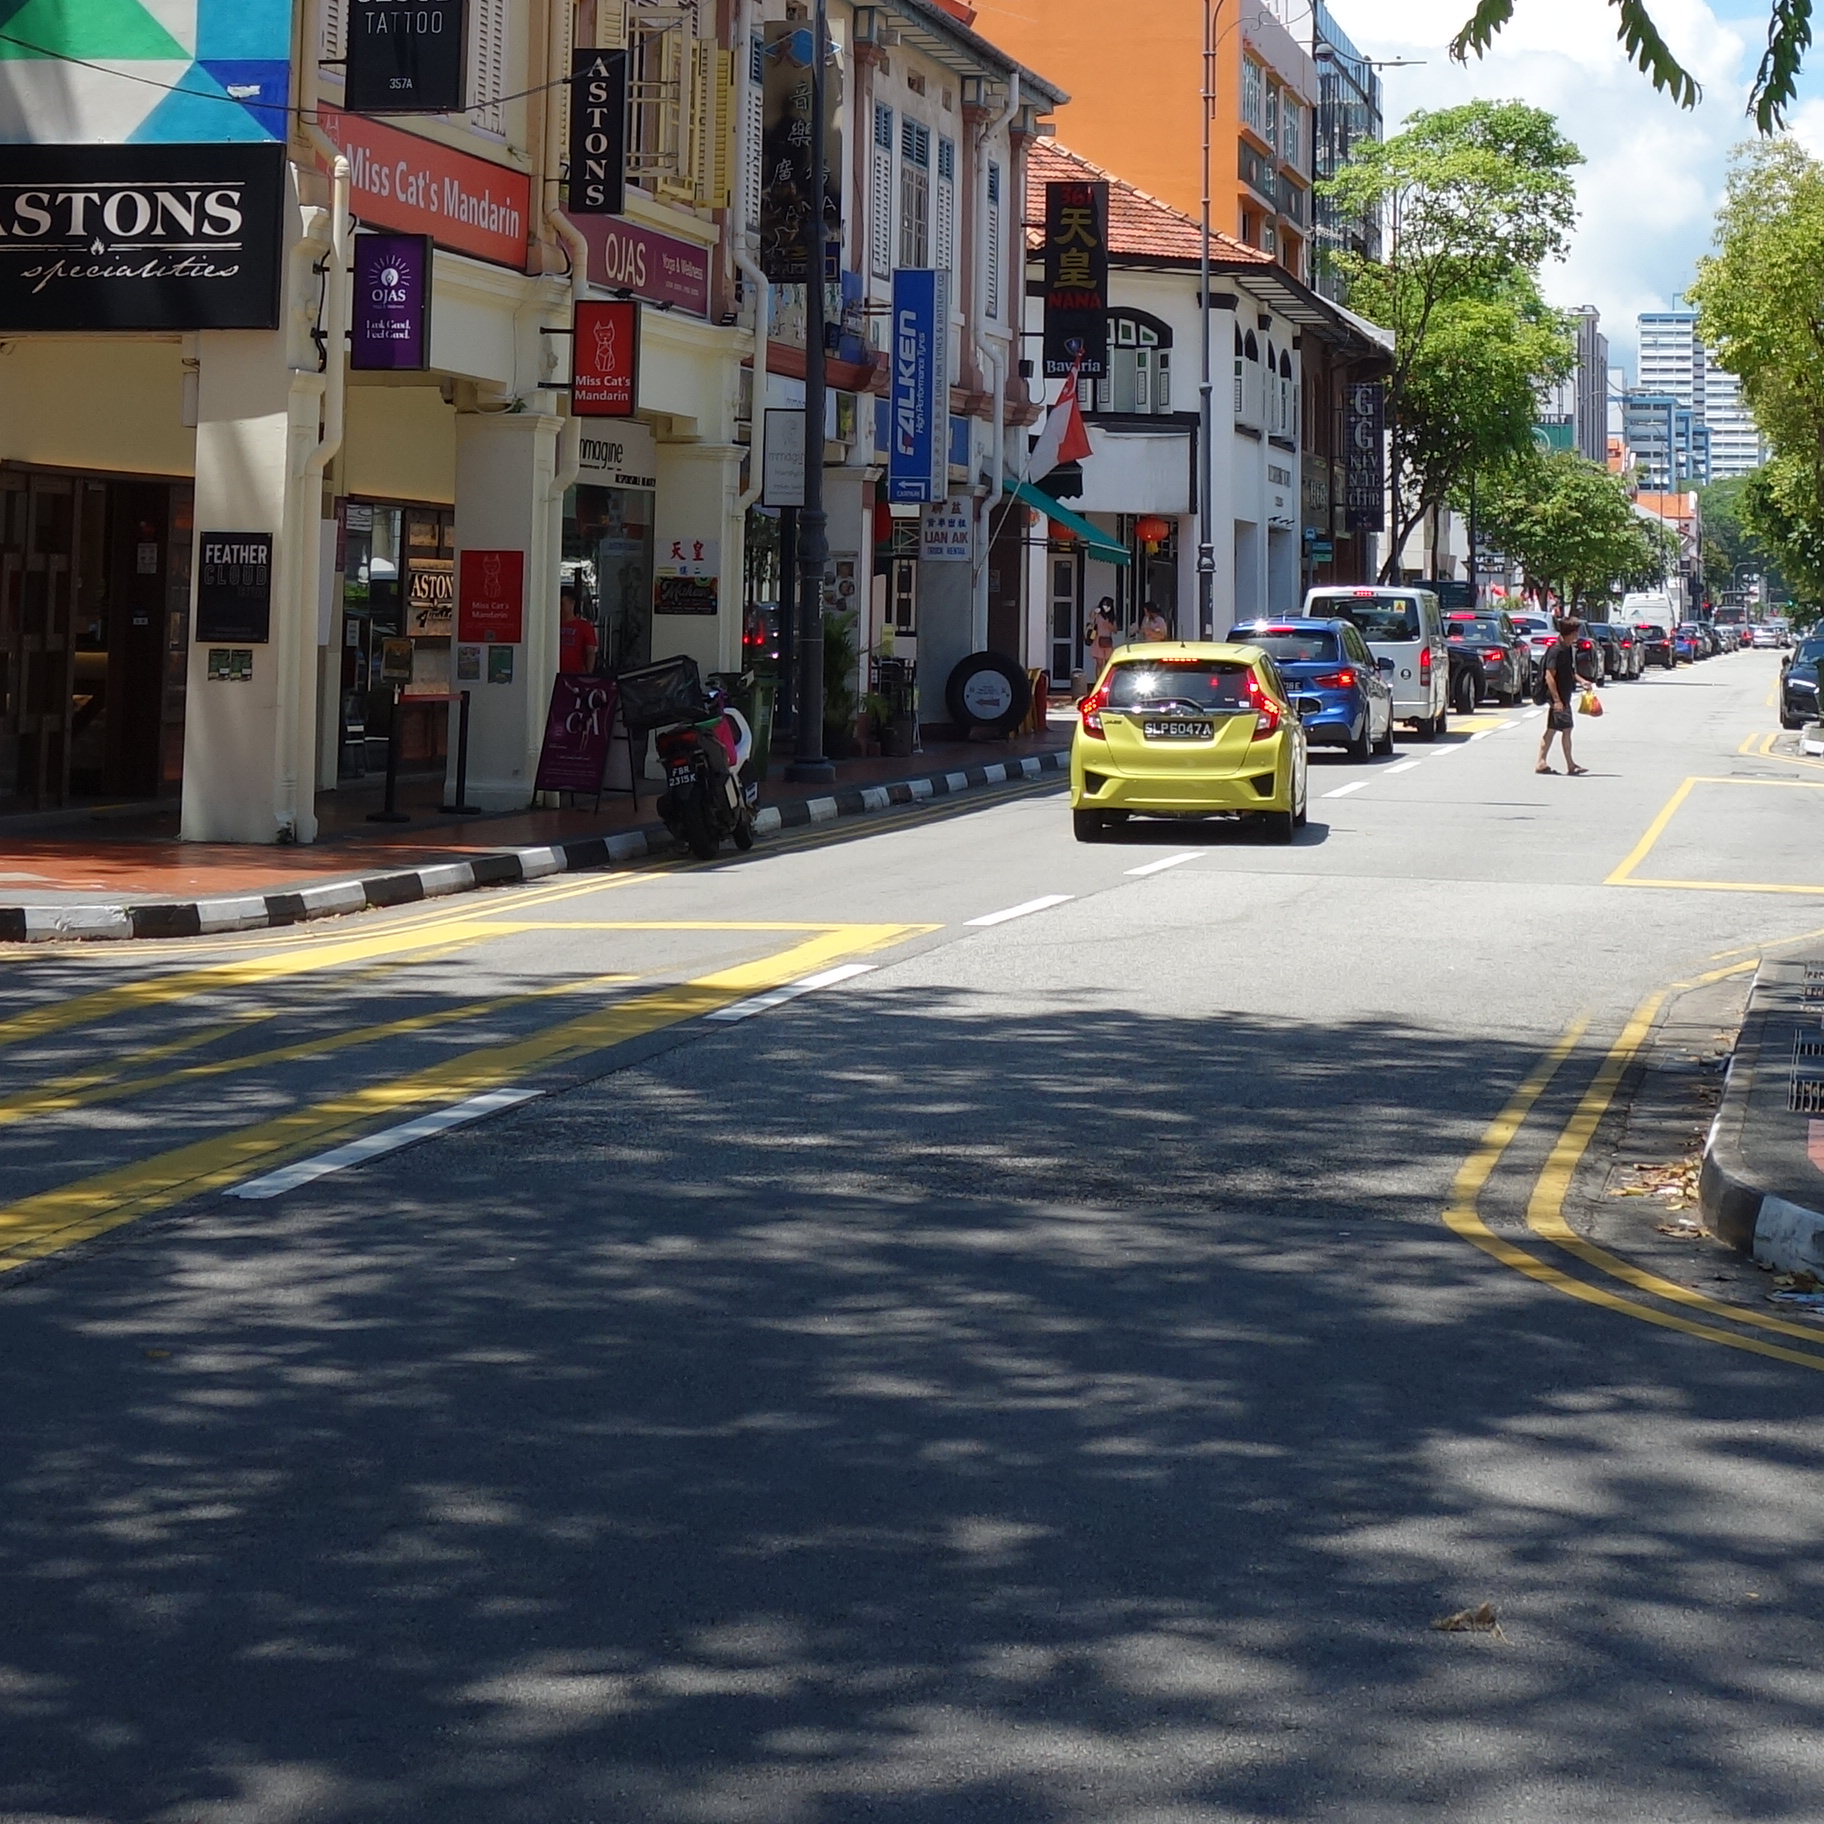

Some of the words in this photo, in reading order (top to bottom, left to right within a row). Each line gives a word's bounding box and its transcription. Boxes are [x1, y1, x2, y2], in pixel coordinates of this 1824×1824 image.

[364, 10, 444, 35] TATTOO
[388, 78, 413, 90] 357A
[584, 56, 609, 207] ASTONS
[346, 148, 390, 196] Miss
[394, 160, 438, 210] Cat's
[443, 176, 520, 238] Mandarin
[1054, 207, 1097, 289] 天皇
[605, 233, 646, 287] OJAS
[21, 256, 240, 293] specialities
[371, 289, 406, 304] OJAS
[1049, 293, 1102, 309] NANA
[1046, 359, 1101, 374] Bavria
[575, 376, 601, 386] Miss
[604, 375, 631, 386] Cat's
[897, 309, 917, 456] FALKEN
[575, 390, 628, 401] Mandarin
[925, 531, 947, 543] LIAN
[952, 532, 968, 543] AIK
[206, 544, 267, 564] FEATHER
[671, 540, 704, 561] 天皇
[204, 564, 266, 585] CLOUD
